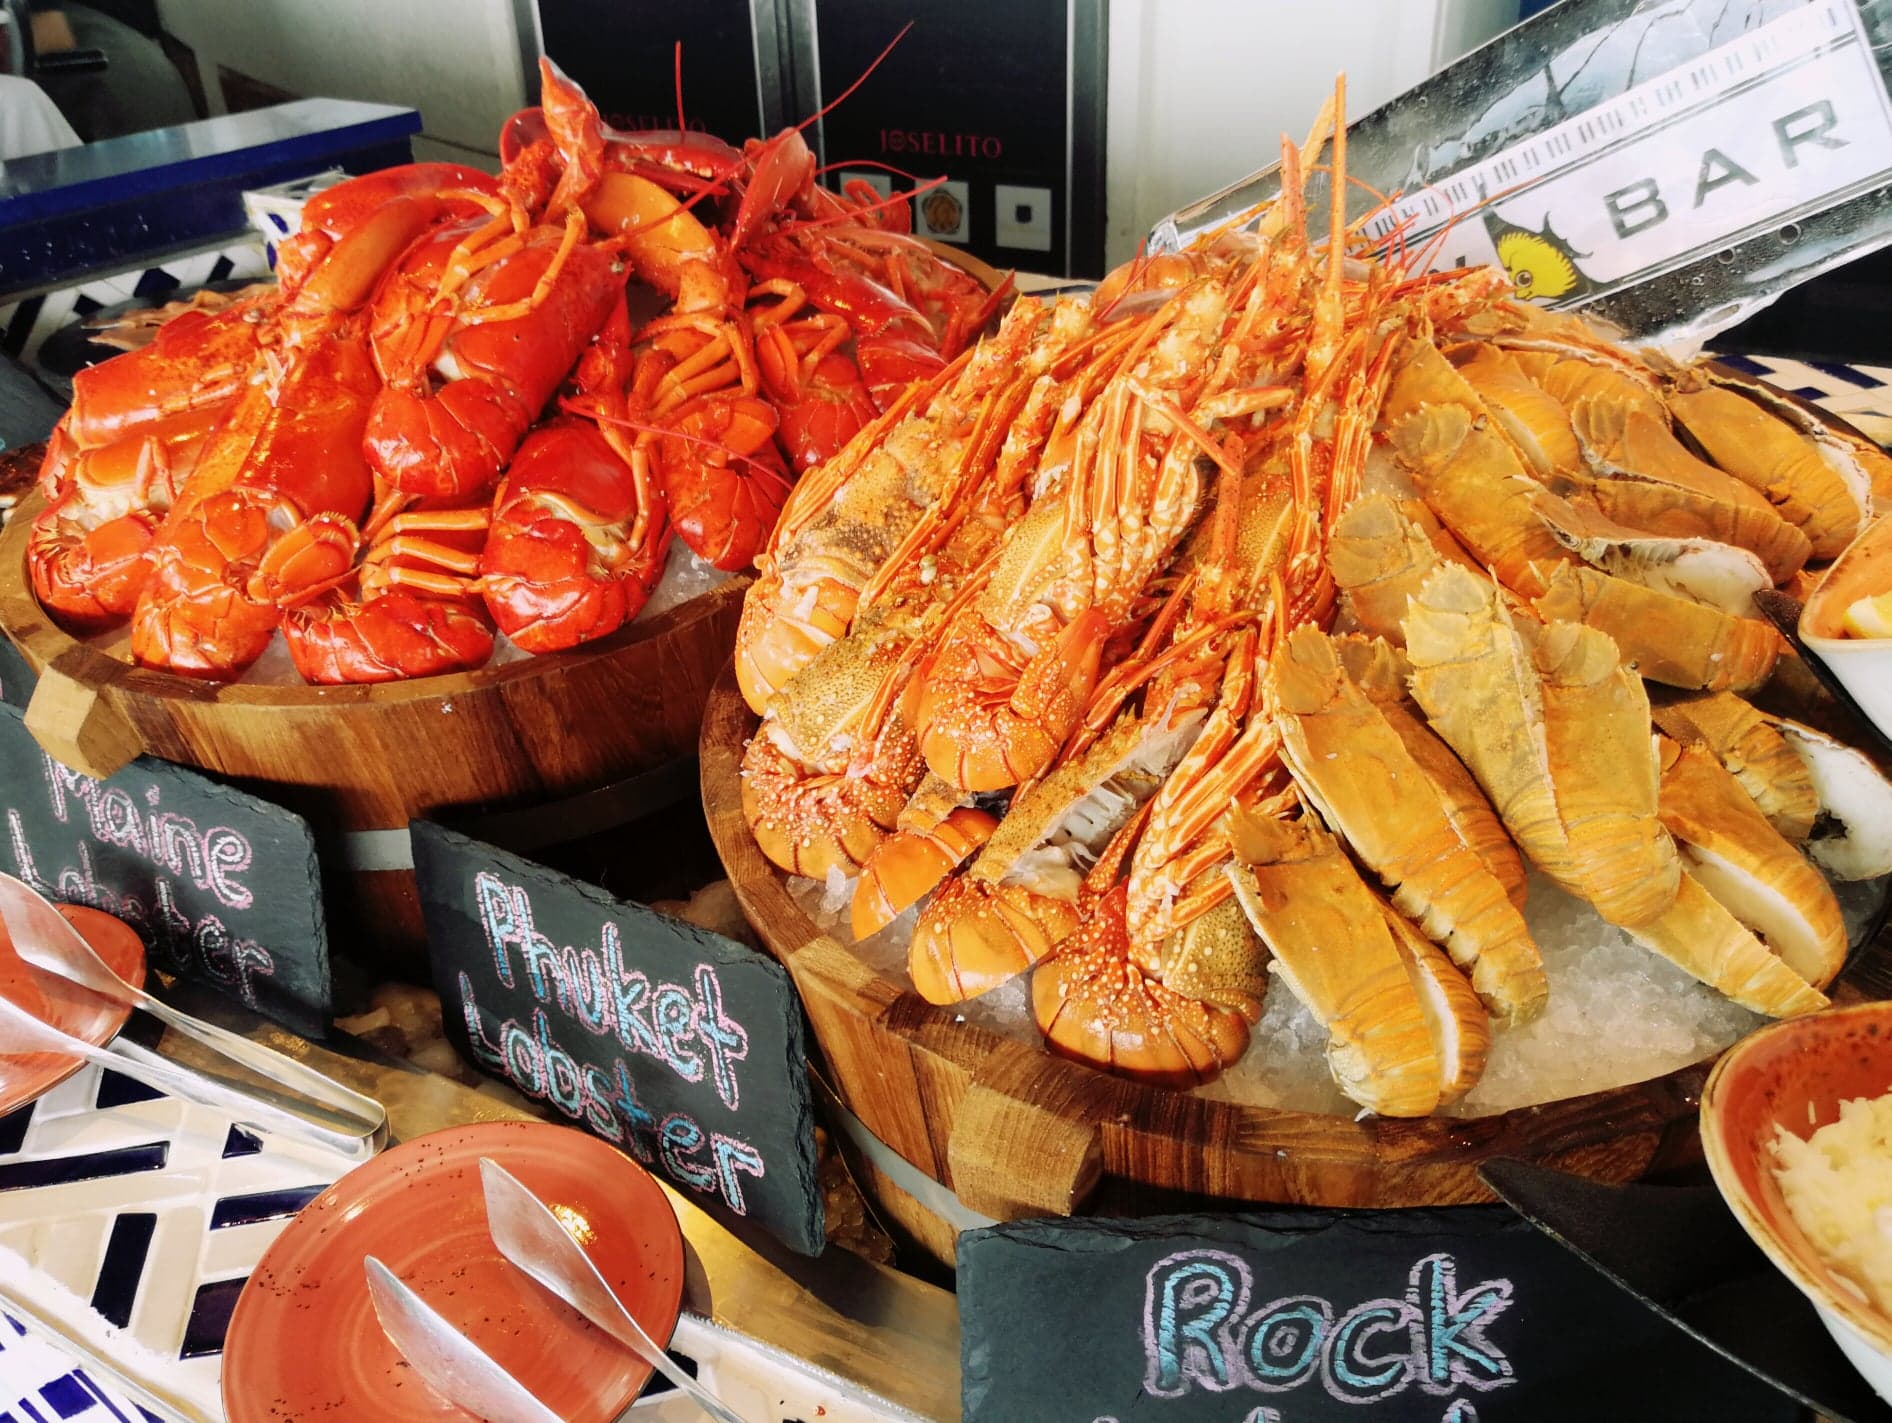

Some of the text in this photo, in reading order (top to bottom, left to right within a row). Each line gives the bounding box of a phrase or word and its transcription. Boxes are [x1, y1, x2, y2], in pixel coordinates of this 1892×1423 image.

[602, 112, 709, 133] OSELIO
[880, 128, 1002, 159] JOSELITO
[1603, 99, 1851, 240] BAR
[41, 750, 253, 909] Maine
[474, 871, 748, 1111] Phuket
[458, 970, 765, 1216] Lobster
[1142, 1248, 1518, 1404] Rock
